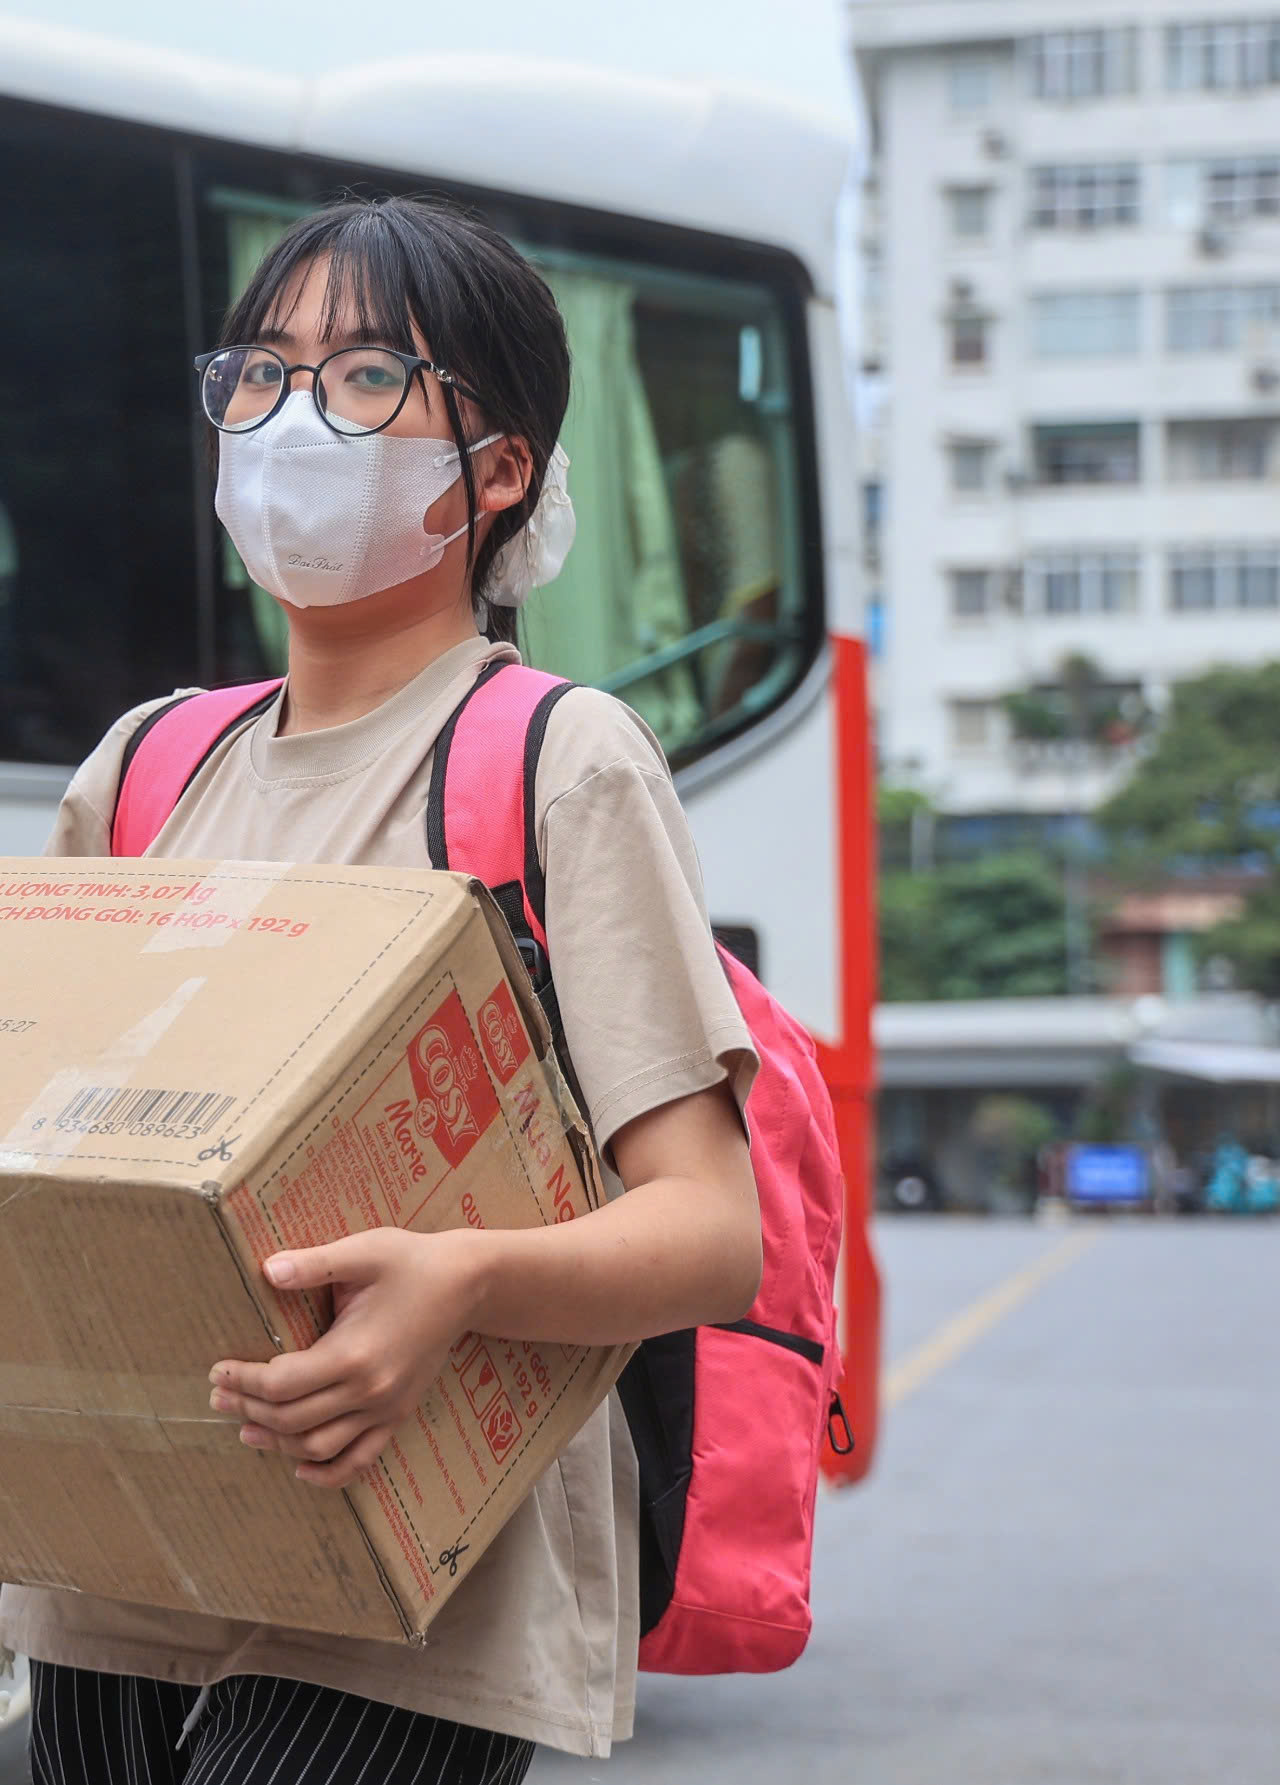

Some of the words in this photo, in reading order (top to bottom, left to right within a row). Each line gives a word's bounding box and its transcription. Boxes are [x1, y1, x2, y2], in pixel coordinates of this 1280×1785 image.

[131, 884, 186, 901] 3,07
[182, 881, 218, 906] kg
[23, 903, 96, 921] ĐÓNG
[94, 905, 145, 924] GÓI:
[145, 911, 174, 927] 16
[173, 909, 229, 932] HỘP
[225, 918, 245, 929] x
[247, 917, 292, 932] 192
[287, 921, 311, 938] g
[481, 1001, 518, 1075] COSY
[416, 1024, 480, 1147] COSY
[31, 1117, 47, 1131] 8
[57, 1118, 126, 1135] 934680
[128, 1122, 203, 1140] 089623
[384, 1099, 427, 1182] Marie
[388, 1150, 400, 1173] Quy
[513, 1361, 532, 1401] 192
[526, 1401, 538, 1418] g
